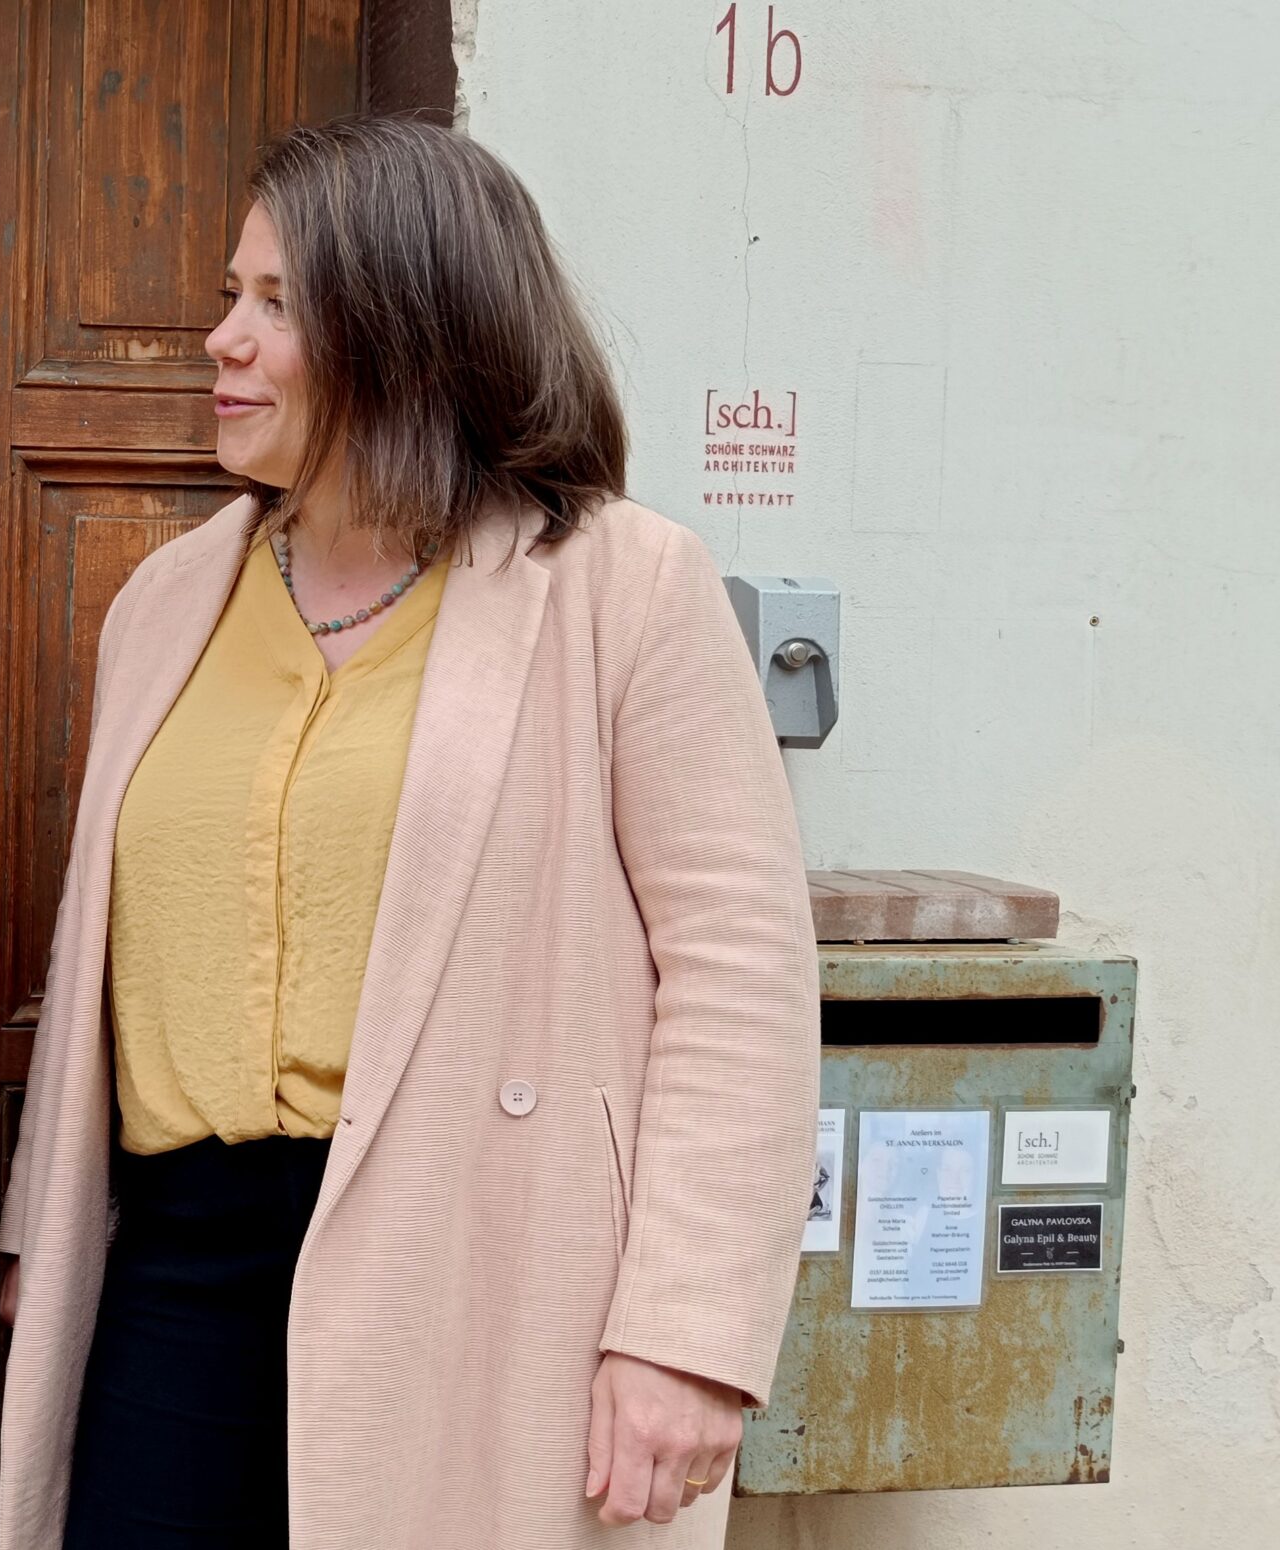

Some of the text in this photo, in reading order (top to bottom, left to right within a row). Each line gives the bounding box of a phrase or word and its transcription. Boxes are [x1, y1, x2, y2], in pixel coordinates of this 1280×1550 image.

[705, 389, 797, 437] [sch.]
[705, 441, 796, 457] SCHÖNE SCHWARZ
[704, 460, 795, 474] ARCHITEKTUR
[703, 492, 795, 506] WERKSTATT
[896, 1139, 920, 1147] ANNEN
[922, 1139, 964, 1147] WERKSALON
[1018, 1131, 1059, 1151] [sch.]
[1011, 1217, 1092, 1226] GALYNA PAVLOVSKA
[1003, 1233, 1098, 1246] Galyna Epil & Beauty
